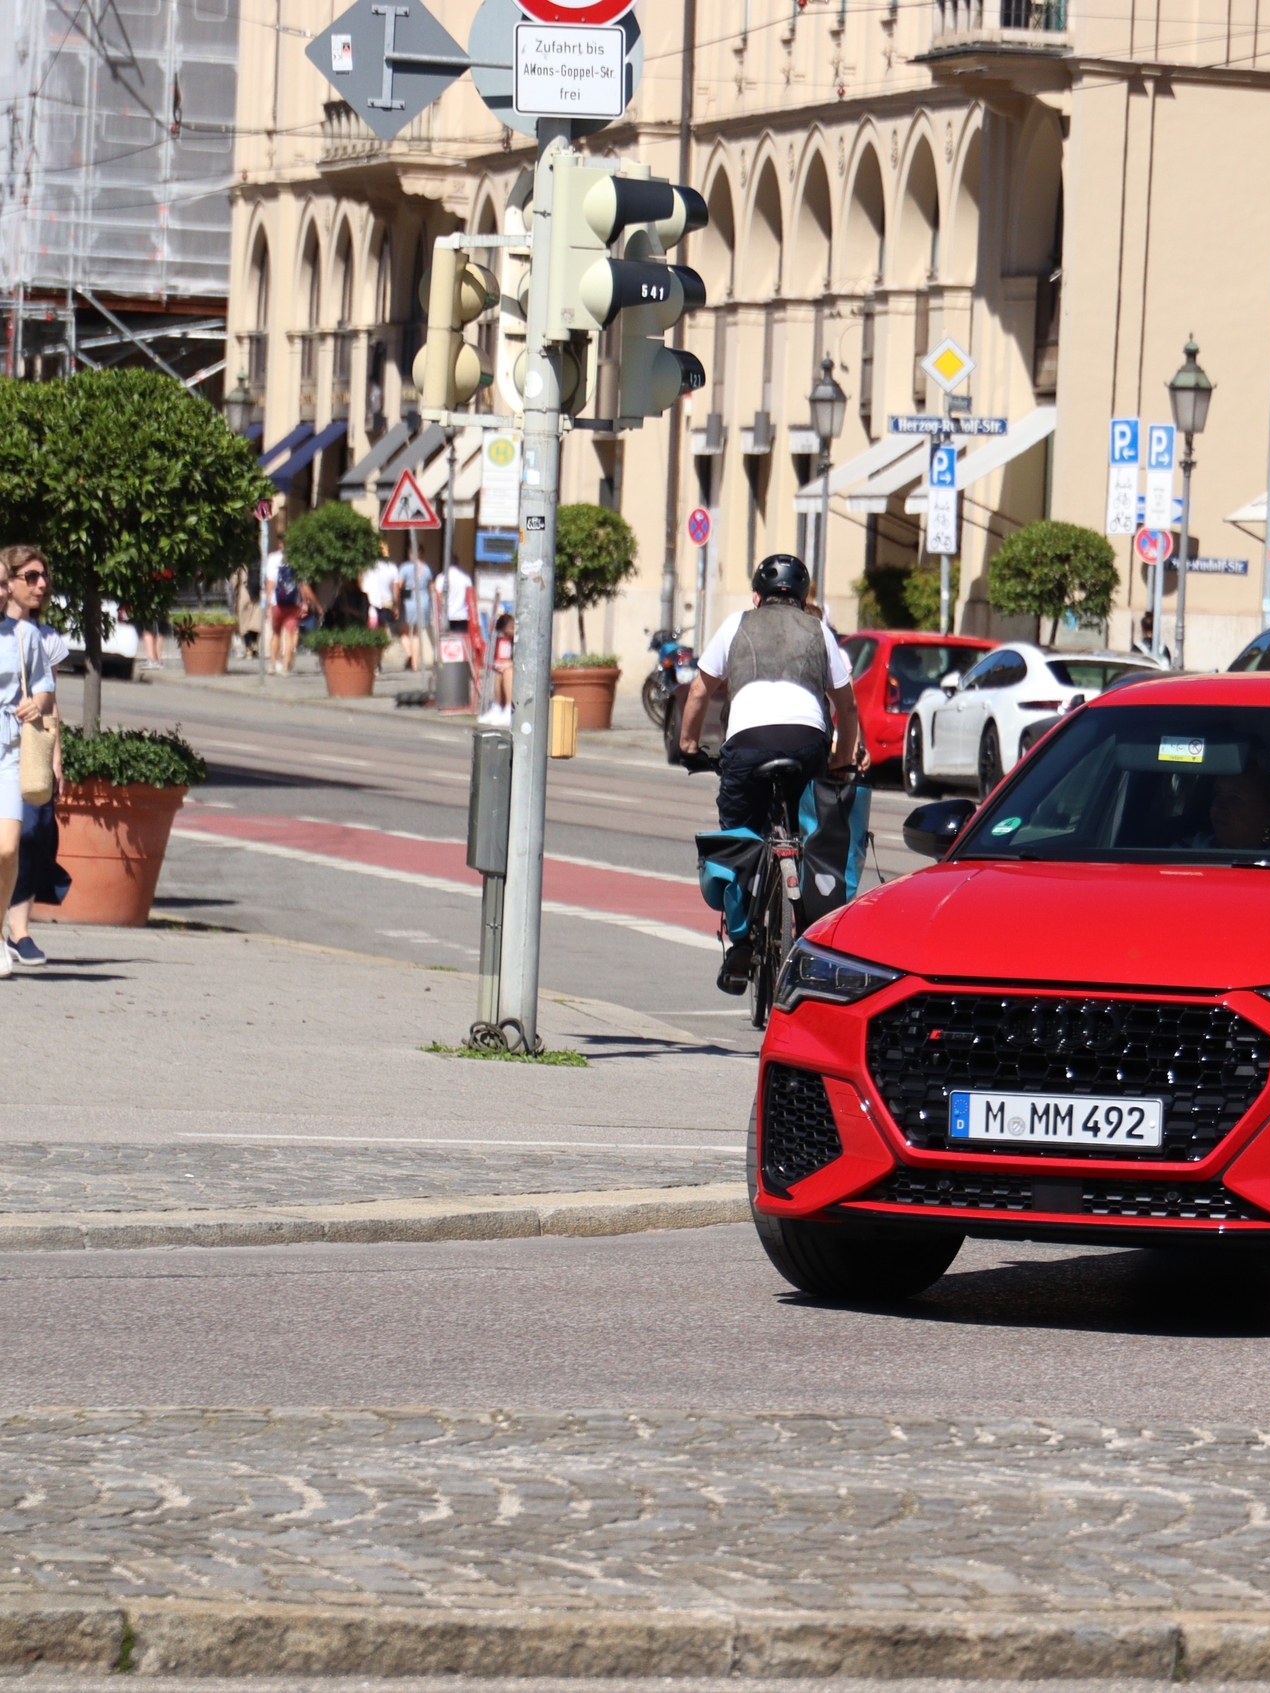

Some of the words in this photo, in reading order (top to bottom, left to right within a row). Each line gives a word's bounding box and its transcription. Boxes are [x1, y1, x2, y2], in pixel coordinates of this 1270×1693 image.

[535, 39, 583, 55] Zufahrt
[586, 41, 605, 56] bis
[559, 87, 581, 101] frei
[641, 283, 664, 301] 541
[956, 1119, 965, 1130] D
[985, 1100, 1006, 1134] M
[1029, 1102, 1074, 1136] MM
[1081, 1104, 1146, 1140] 492
